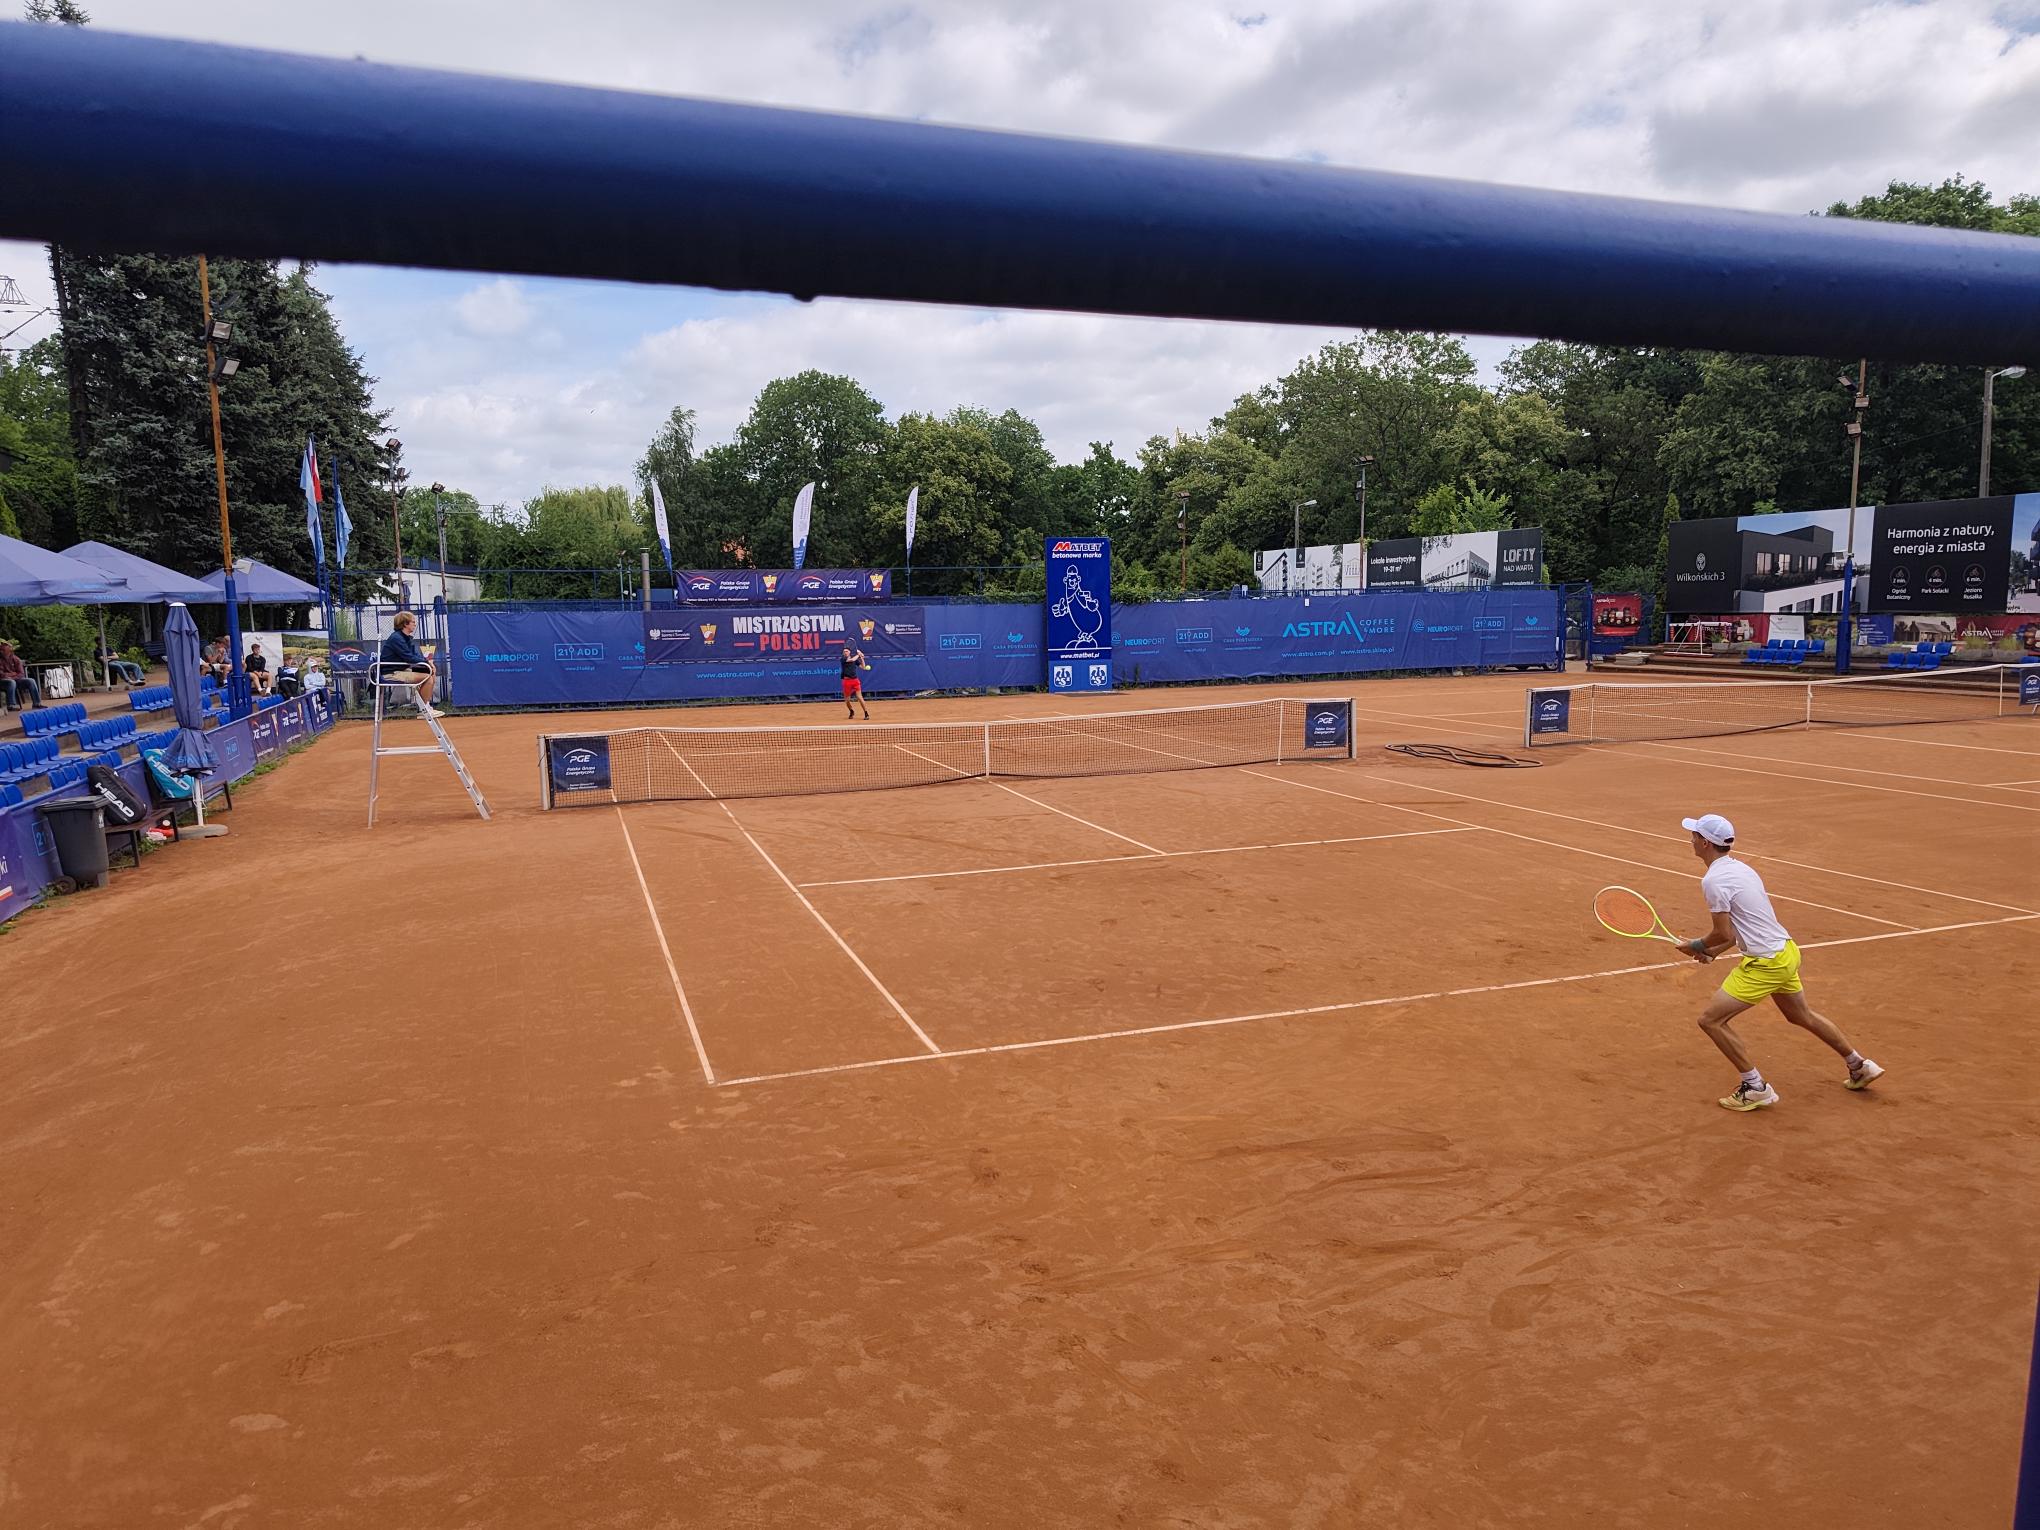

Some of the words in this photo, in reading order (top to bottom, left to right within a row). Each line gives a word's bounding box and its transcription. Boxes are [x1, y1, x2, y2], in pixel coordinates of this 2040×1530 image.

[1887, 526, 1940, 539] Harmonia
[1943, 528, 1950, 537] z
[1953, 524, 1995, 537] natury,
[1052, 541, 1102, 552] MATBET
[1893, 542, 1935, 556] energia
[1937, 544, 1943, 553] z
[1946, 540, 1986, 553] miasta
[1370, 557, 1385, 565] Lokale
[1385, 554, 1417, 565] inwestycyjne
[1503, 548, 1536, 563] LOFTY
[1676, 572, 1719, 582] Wilkońskich
[1720, 571, 1725, 581] 3
[733, 614, 845, 634] MISTRZOSTWA
[1359, 618, 1395, 626] COFFEE
[1282, 620, 1352, 638] ASTRA
[1427, 625, 1464, 633] NEUROPORT
[760, 633, 820, 651] POLSKI
[958, 638, 977, 646] ADD
[1124, 637, 1166, 647] NEUROPORT
[558, 648, 569, 656] 21
[577, 648, 599, 656] ADD
[338, 654, 360, 662] PGE
[485, 653, 540, 662] NEUROPORT
[696, 670, 765, 679] www.astra.com.pl
[1317, 717, 1334, 725] PGE
[569, 754, 591, 764] PGE
[95, 782, 135, 818] HEAD
